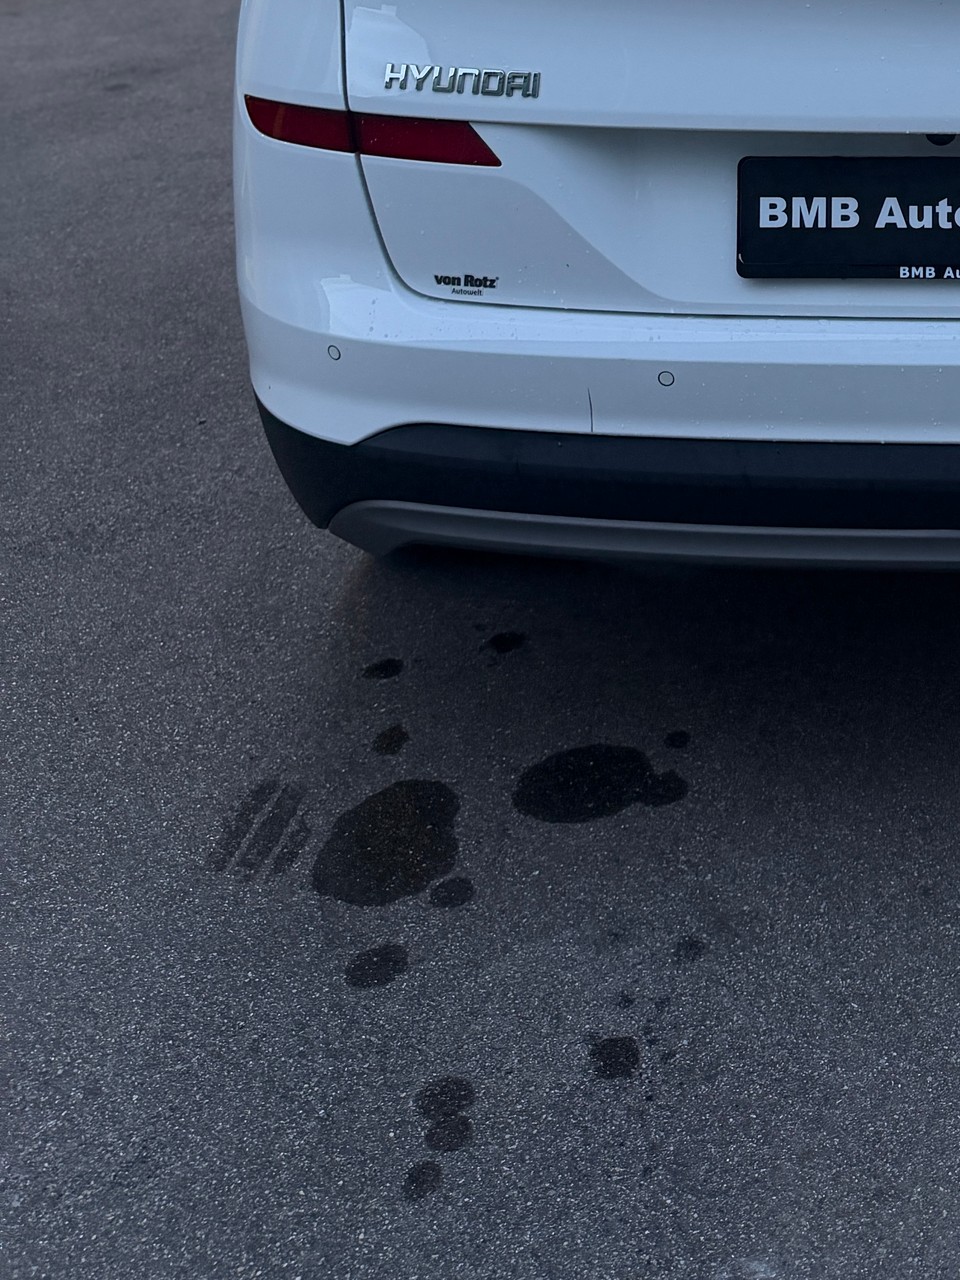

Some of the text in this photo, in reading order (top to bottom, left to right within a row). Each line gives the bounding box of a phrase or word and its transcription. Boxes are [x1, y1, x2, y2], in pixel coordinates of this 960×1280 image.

[384, 63, 541, 98] HYUNDAI
[759, 196, 860, 229] BMB
[899, 266, 936, 279] BMB
[434, 274, 497, 288] von Rotz
[451, 287, 483, 296] Autowelt
